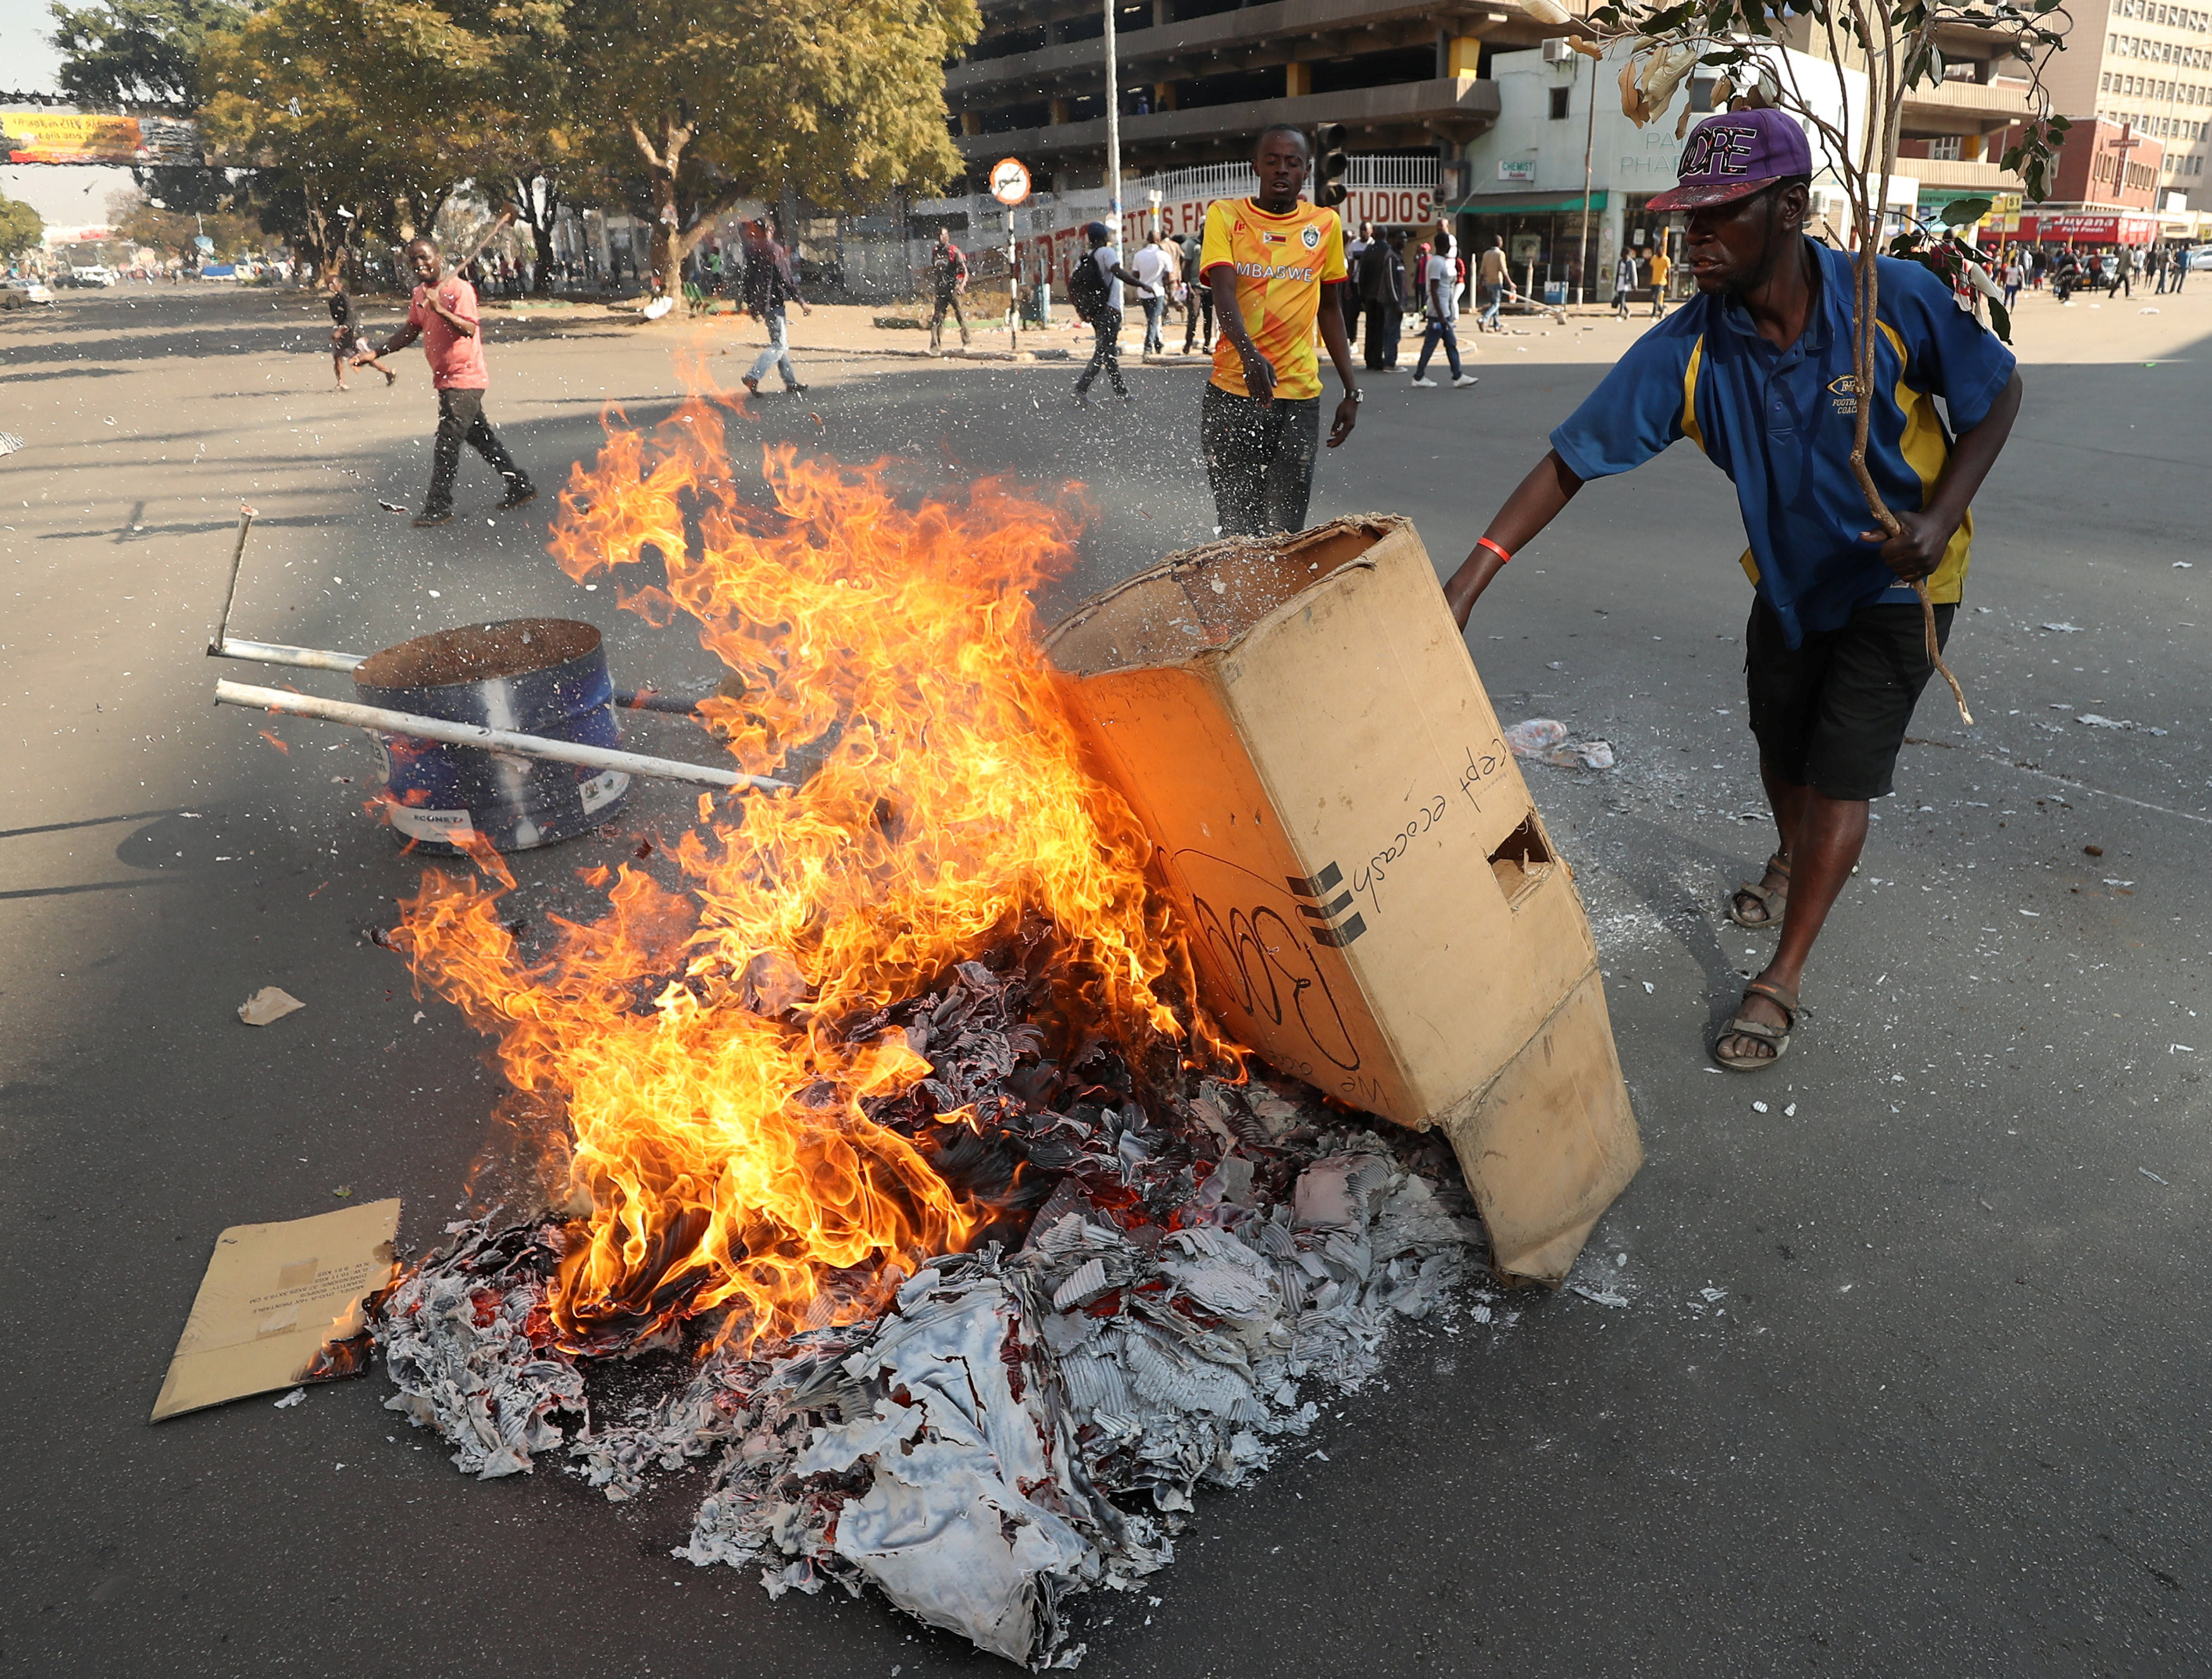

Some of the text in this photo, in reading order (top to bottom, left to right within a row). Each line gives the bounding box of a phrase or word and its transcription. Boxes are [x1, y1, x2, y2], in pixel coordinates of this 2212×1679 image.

[1502, 161, 1533, 171] CHEMIST
[1330, 192, 1431, 223] TUDIOS
[2055, 216, 2115, 227] Juvana
[1236, 261, 1313, 283] MBABWE
[1353, 795, 1446, 913] ecocash
[1340, 1075, 1390, 1110] We
